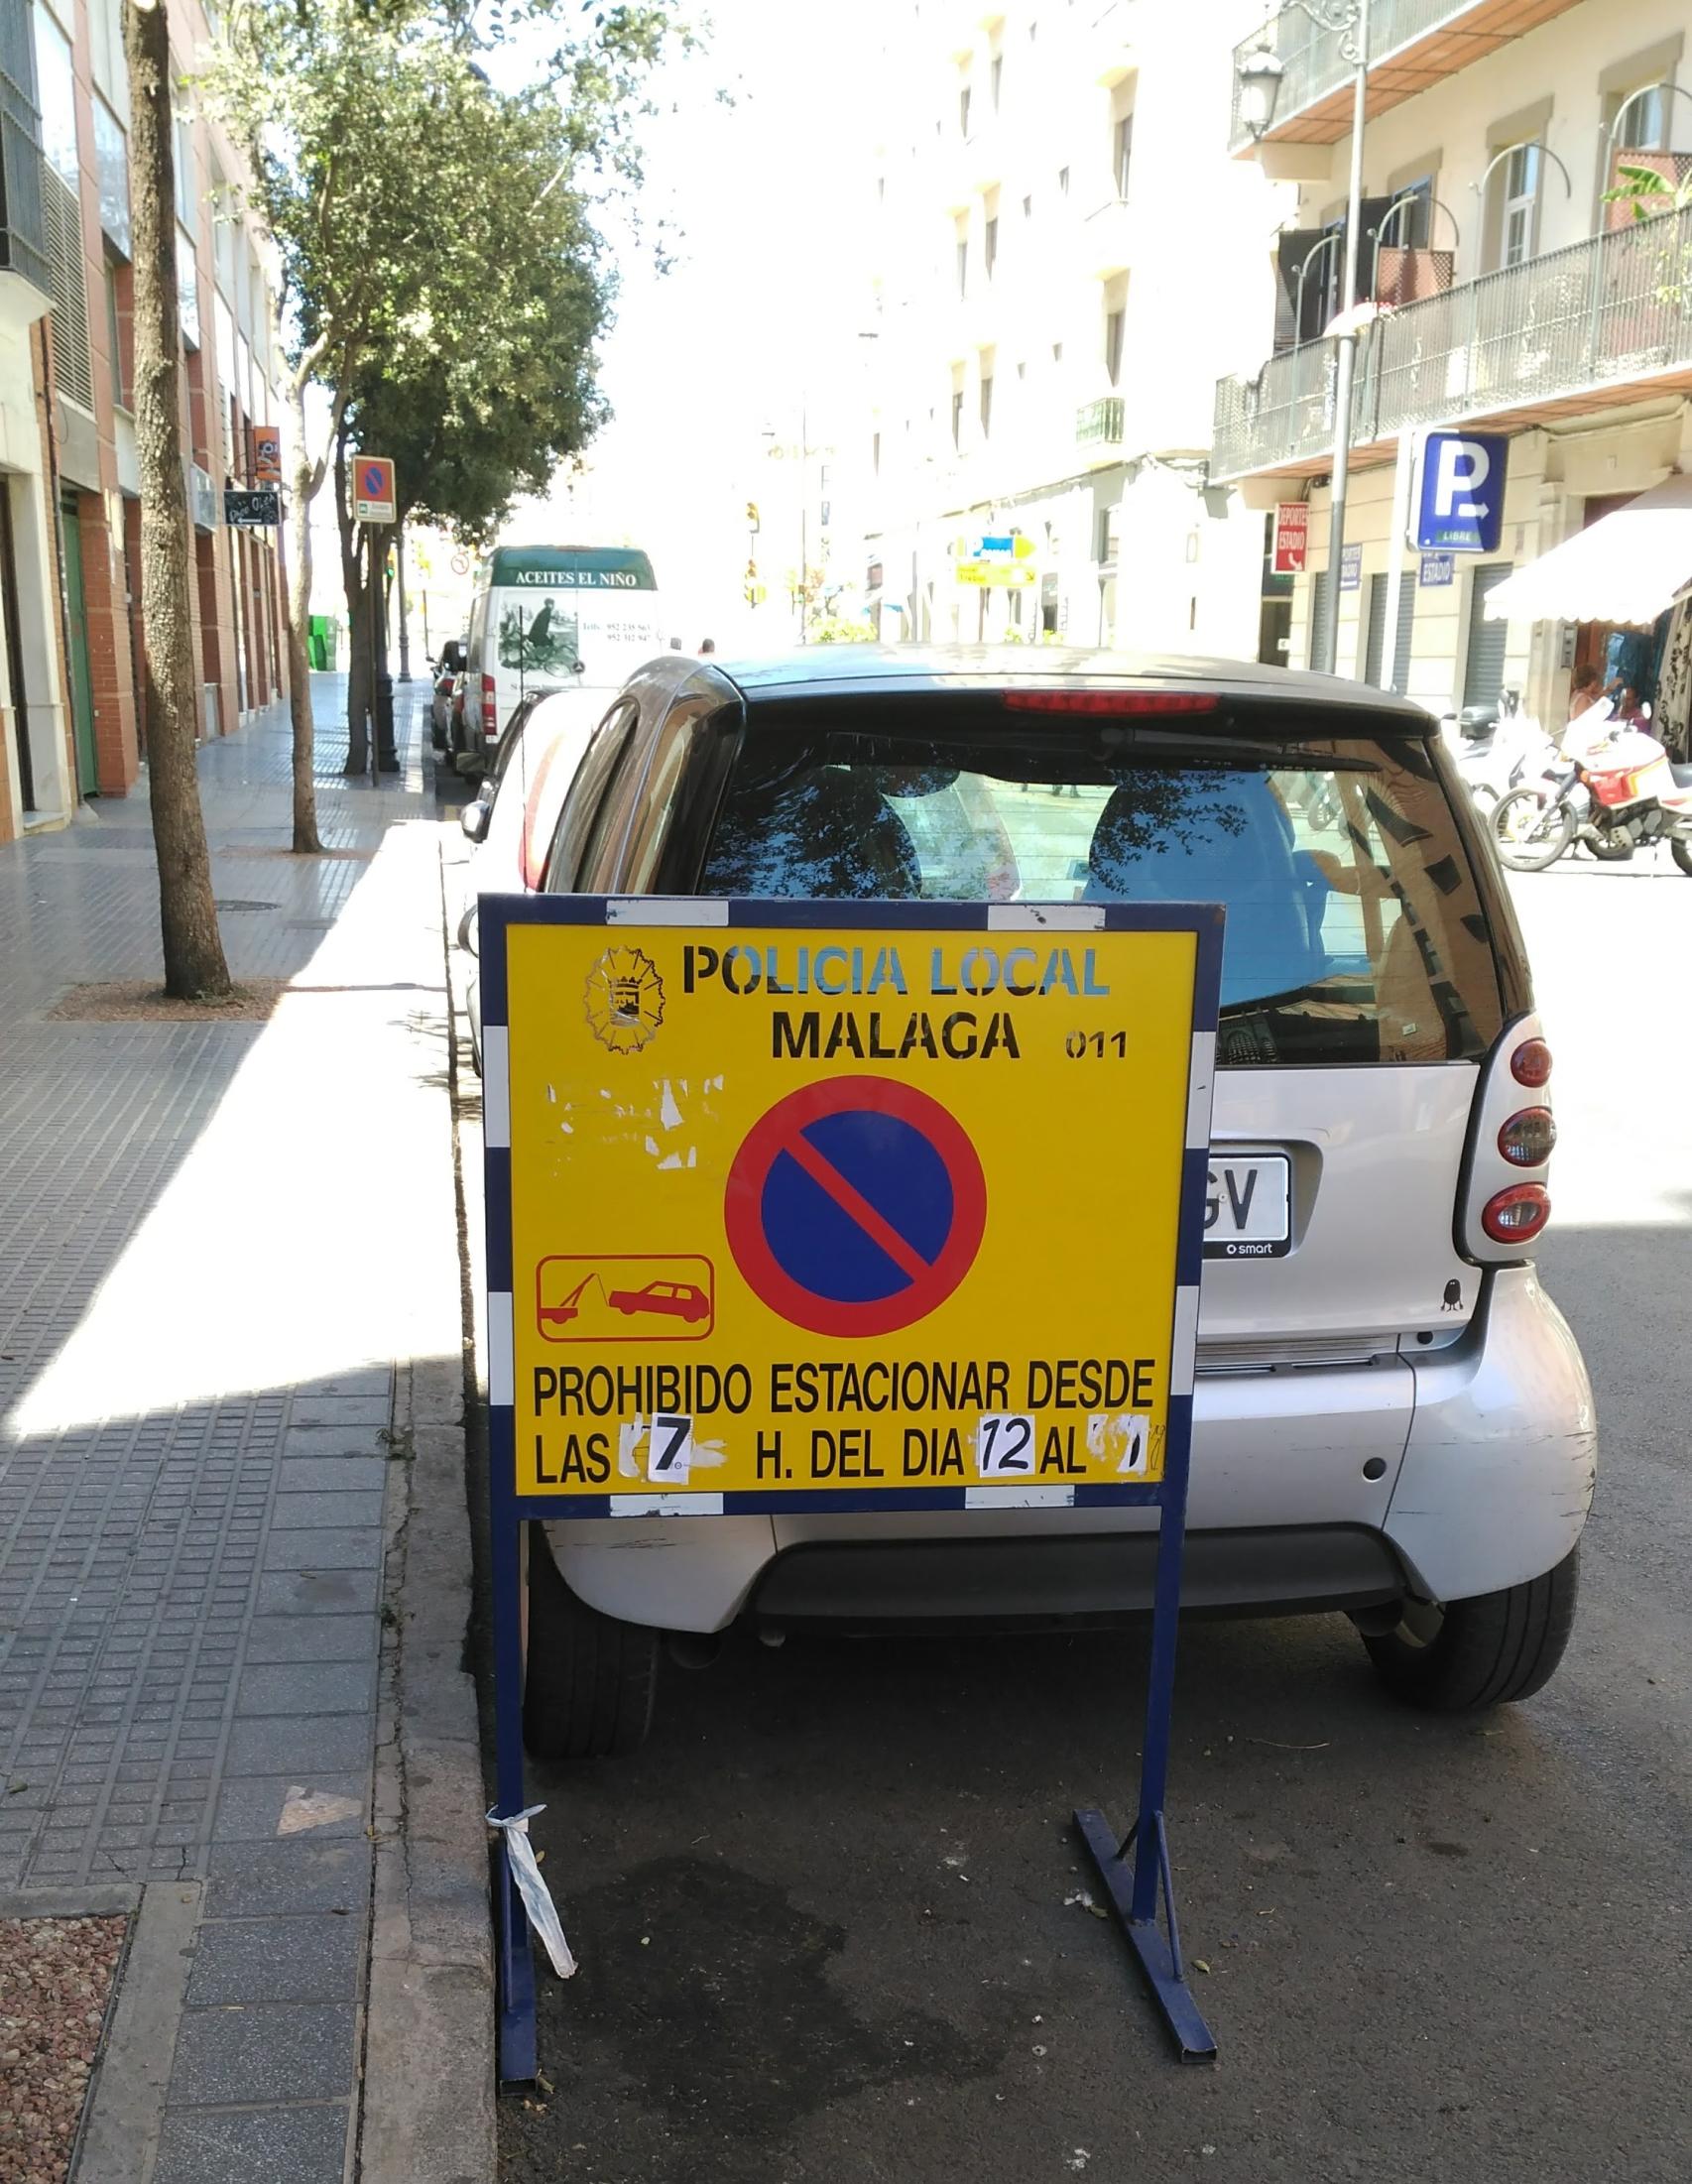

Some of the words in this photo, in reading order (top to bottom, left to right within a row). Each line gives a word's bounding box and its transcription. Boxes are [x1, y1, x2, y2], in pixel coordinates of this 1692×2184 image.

[1435, 440, 1490, 516] P
[1278, 531, 1305, 549] ESTADIO
[1443, 532, 1471, 542] LIBRE
[516, 570, 575, 584] ACEITES
[578, 572, 596, 585] EL
[599, 571, 637, 586] NIÑO
[1422, 560, 1451, 583] ESTADIO
[683, 945, 907, 996] POLICIA
[930, 947, 1110, 997] LOCAL
[773, 1011, 1021, 1059] MALAGA
[1066, 1031, 1127, 1058] 011
[1239, 1243, 1272, 1254] smart
[534, 1363, 752, 1416] PROHIBIDO
[771, 1361, 1010, 1412] ESTACIONAR
[1027, 1359, 1155, 1409] DESDE
[535, 1433, 610, 1483] LAS
[756, 1430, 792, 1479] H.
[810, 1429, 884, 1478] DEL
[904, 1427, 964, 1477] DIA
[982, 1417, 1031, 1471] 12
[1039, 1426, 1087, 1474] AL
